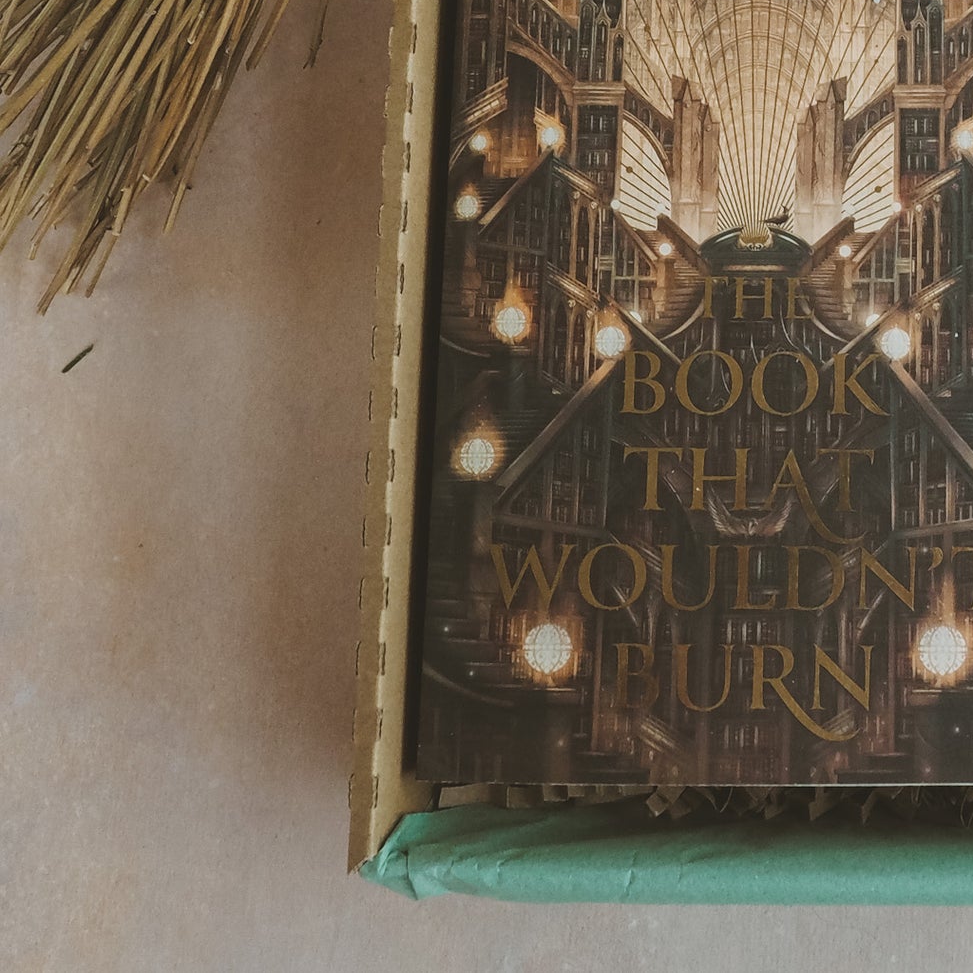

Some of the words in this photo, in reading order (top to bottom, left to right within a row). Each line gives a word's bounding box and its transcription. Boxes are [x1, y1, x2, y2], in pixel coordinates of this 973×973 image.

[698, 274, 818, 320] THE
[618, 349, 889, 418] BOOK
[623, 447, 876, 545] THAT
[614, 643, 872, 742] BURN
